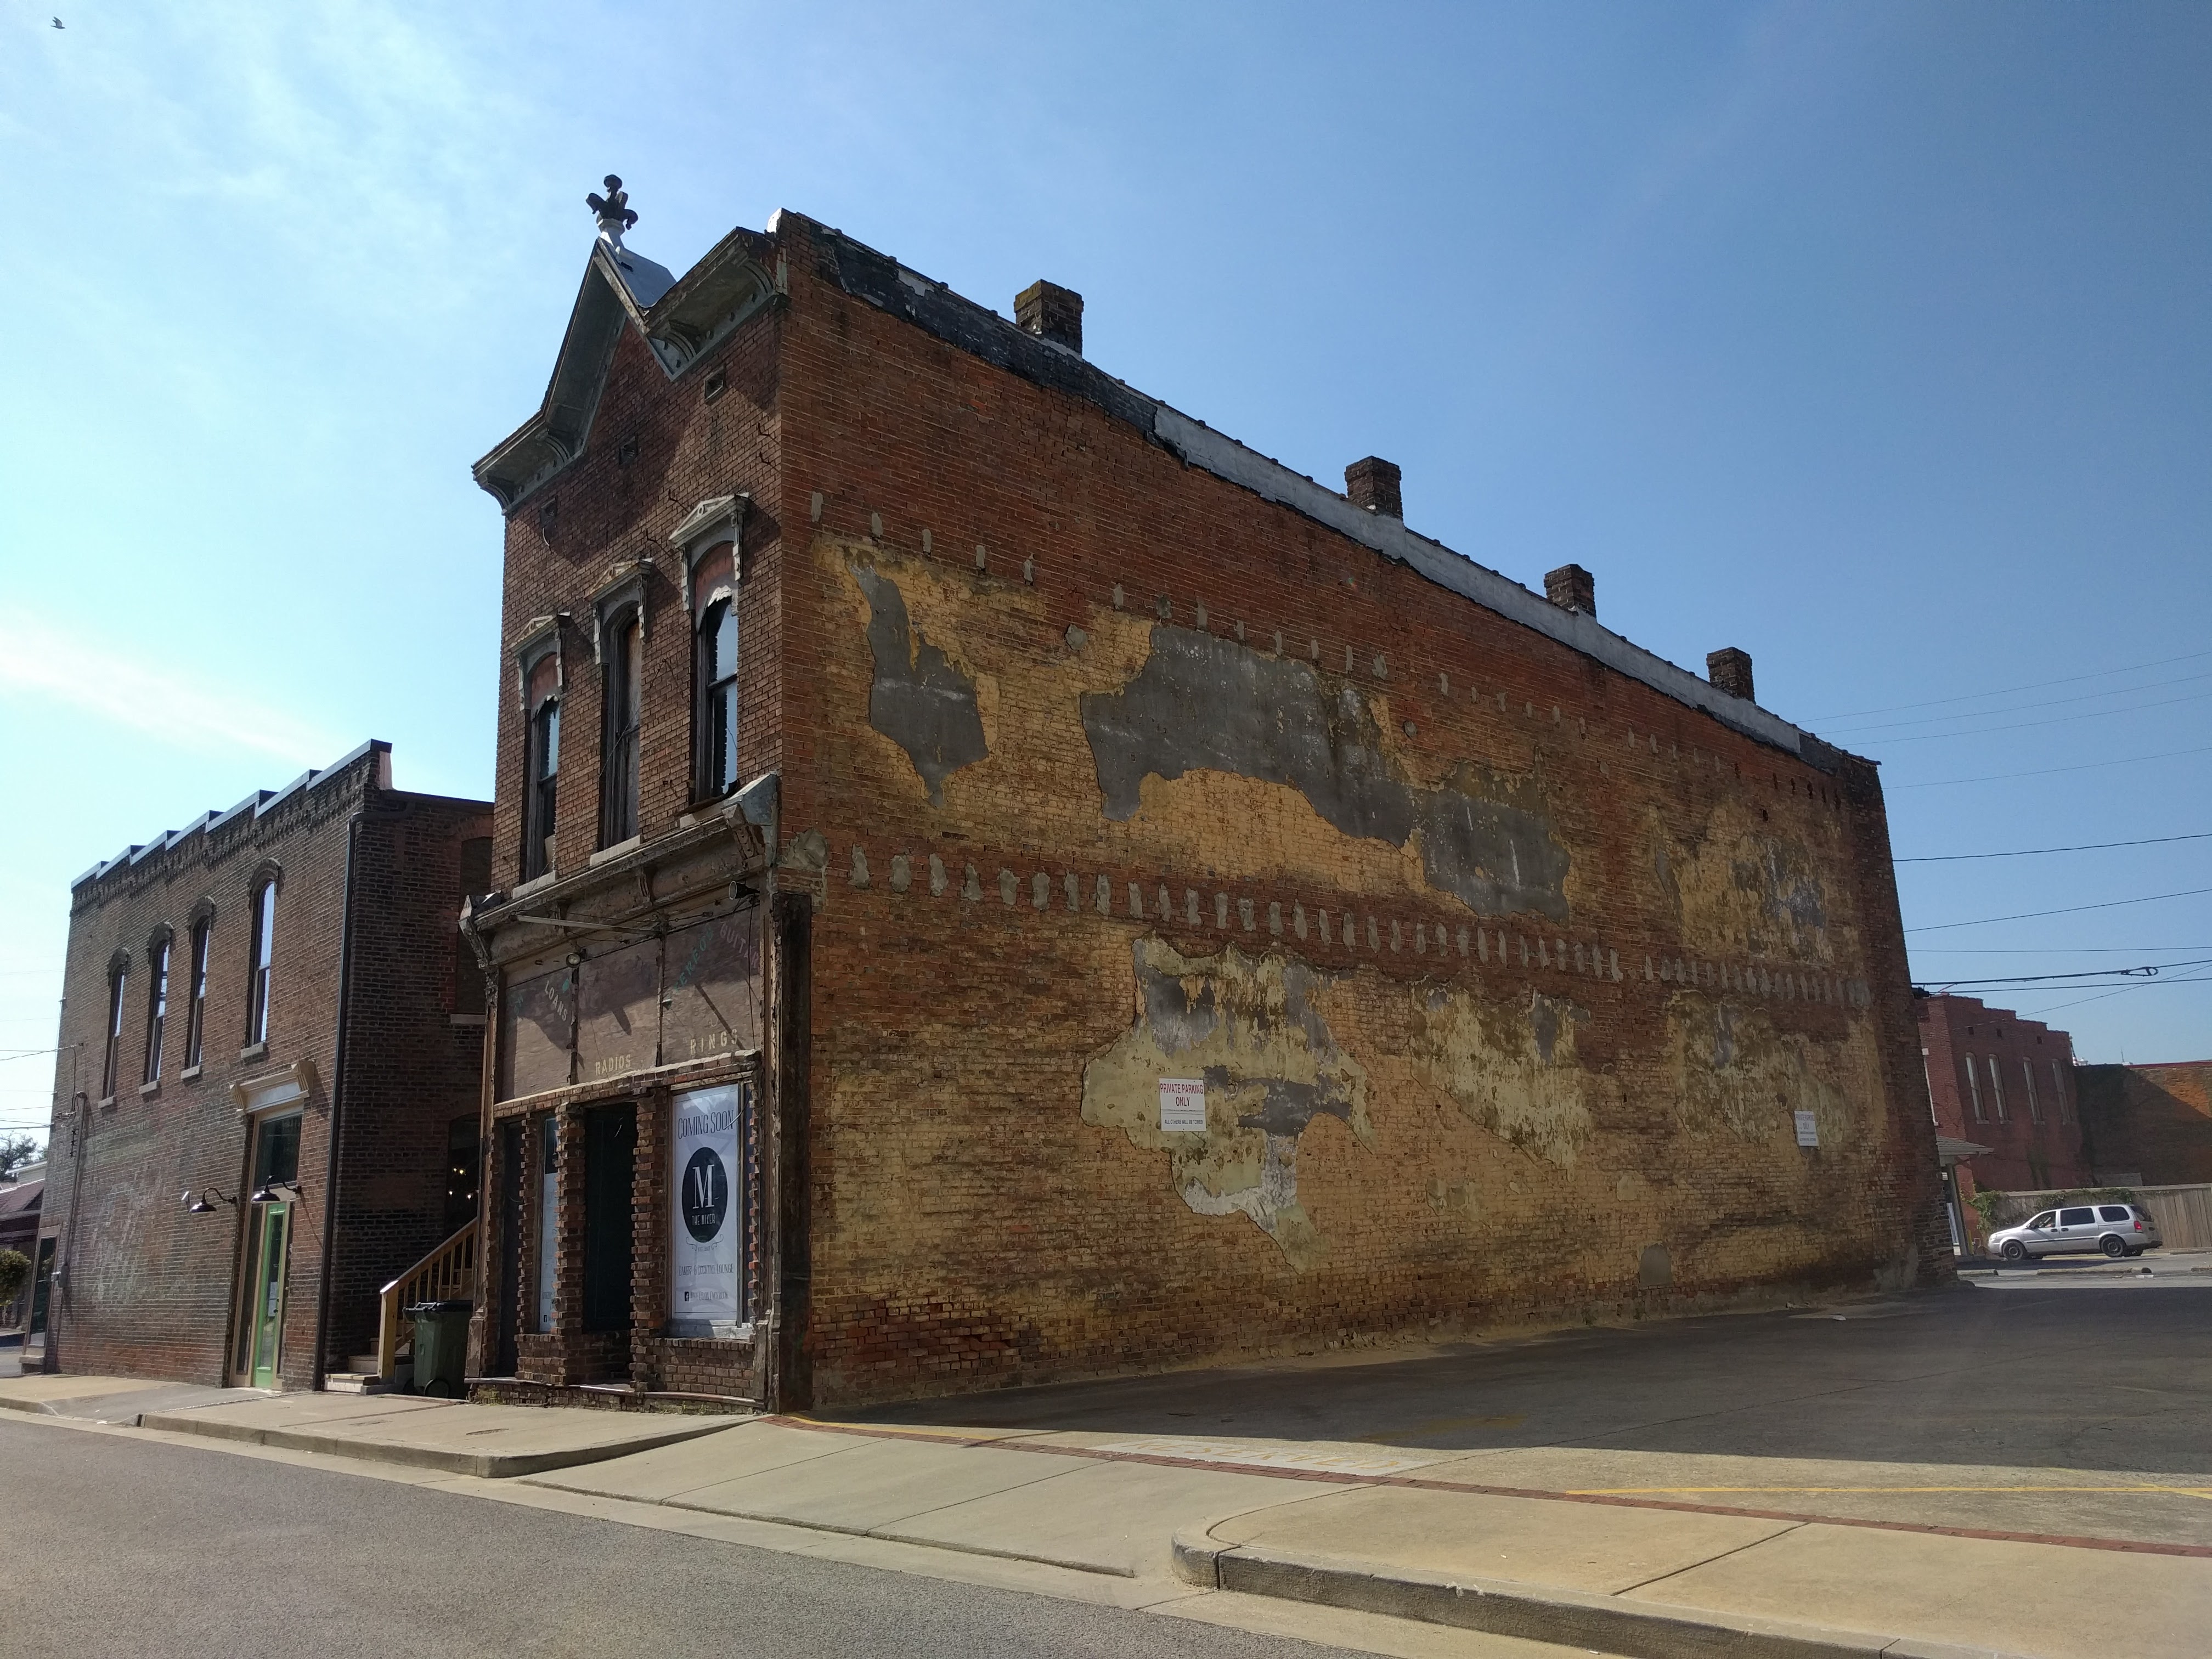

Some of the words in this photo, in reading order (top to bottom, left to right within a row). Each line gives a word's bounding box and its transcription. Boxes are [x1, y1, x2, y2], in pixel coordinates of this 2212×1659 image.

[545, 980, 568, 1022] LOANS
[690, 1029, 738, 1056] RINGS
[595, 1054, 631, 1076] RADIOS
[1160, 1083, 1181, 1093] PRIVATE
[1182, 1084, 1203, 1094] PARKING
[1176, 1097, 1190, 1107] ONLY
[678, 1114, 708, 1139] COMING
[710, 1109, 734, 1133] SOON
[692, 1164, 715, 1209] M
[692, 1215, 700, 1226] THE
[701, 1214, 715, 1224] MIXER
[697, 1265, 715, 1275] COCKTAIL
[716, 1263, 733, 1274] LOUNGE
